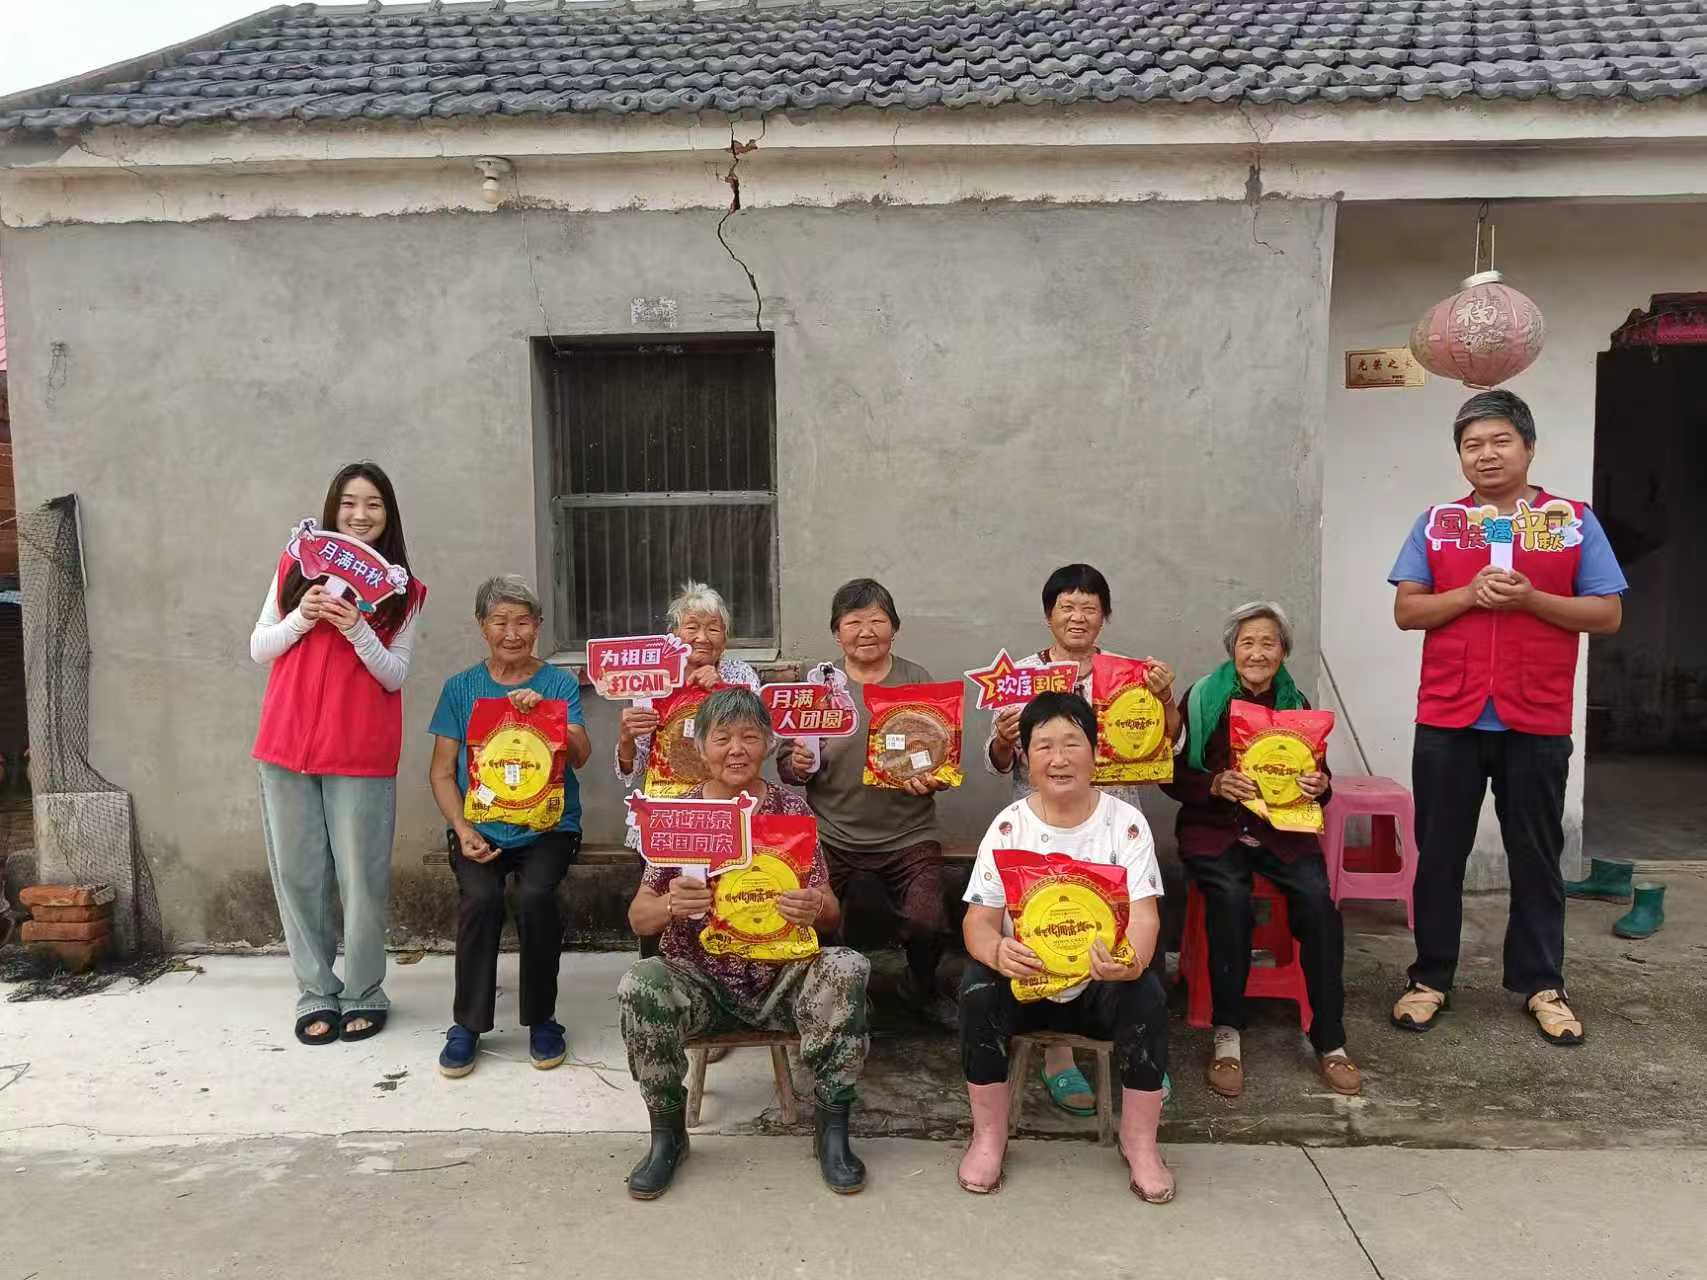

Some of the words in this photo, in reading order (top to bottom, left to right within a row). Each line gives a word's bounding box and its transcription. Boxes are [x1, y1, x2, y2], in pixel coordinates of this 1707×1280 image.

[318, 541, 384, 589] 月满中秋
[600, 648, 661, 666] 为祖国
[771, 689, 814, 708] 月满
[778, 709, 843, 729] 人团圆
[651, 832, 734, 853] 举国同庆
